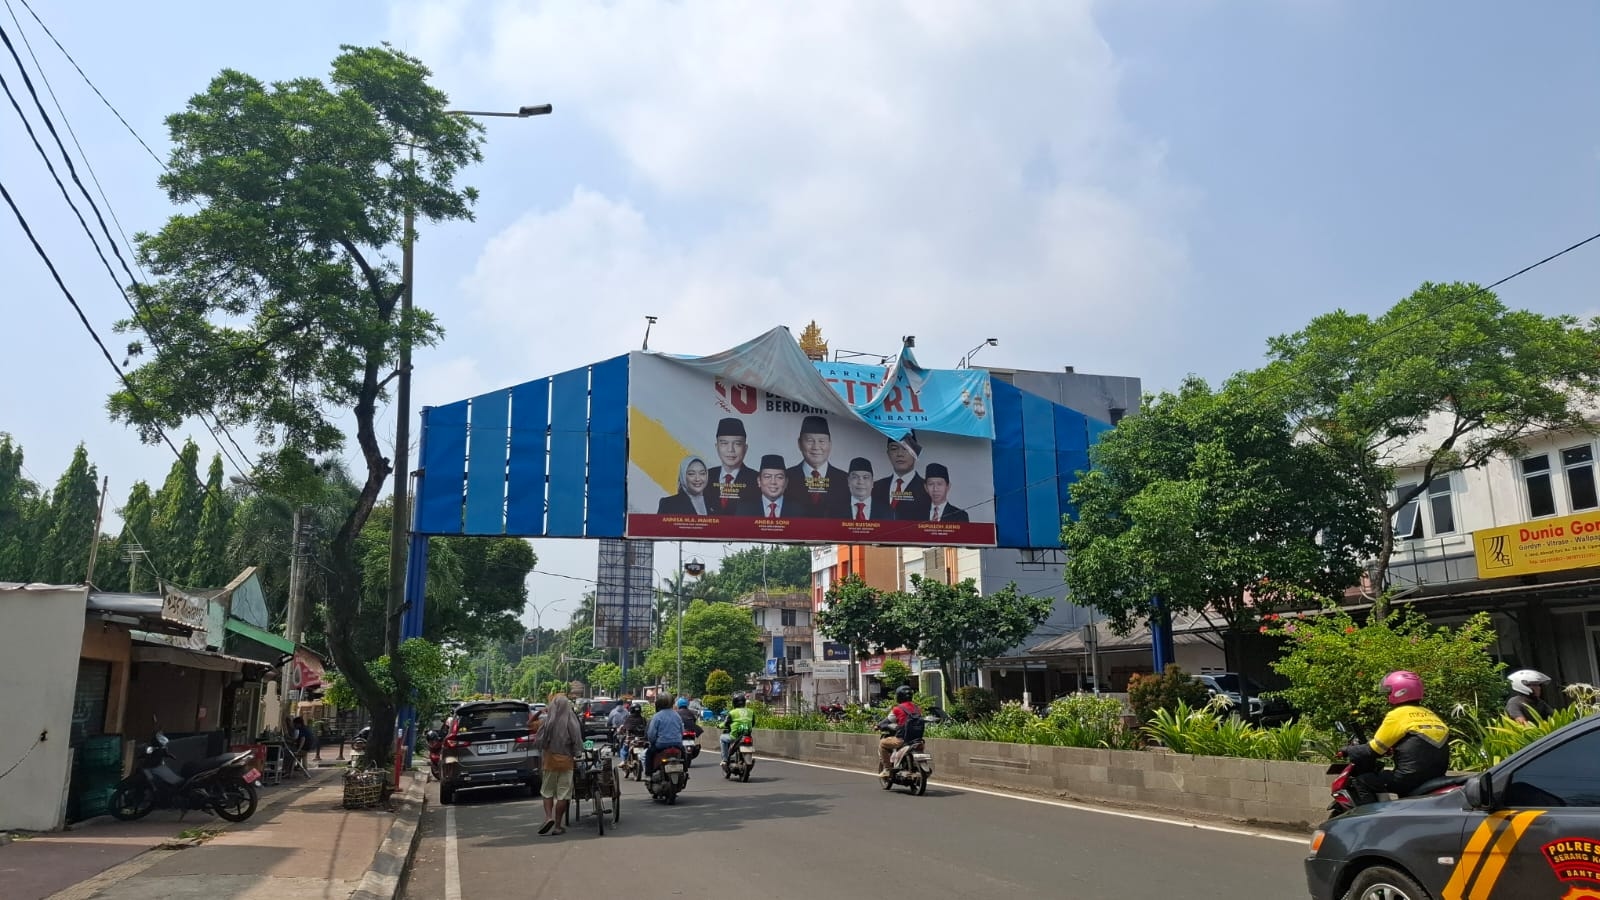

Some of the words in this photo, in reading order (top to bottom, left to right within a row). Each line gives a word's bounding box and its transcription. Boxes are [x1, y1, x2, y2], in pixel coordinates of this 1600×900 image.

[1520, 524, 1564, 542] Dunia
[1548, 841, 1600, 855] POLRES
[1554, 853, 1589, 863] SERANG
